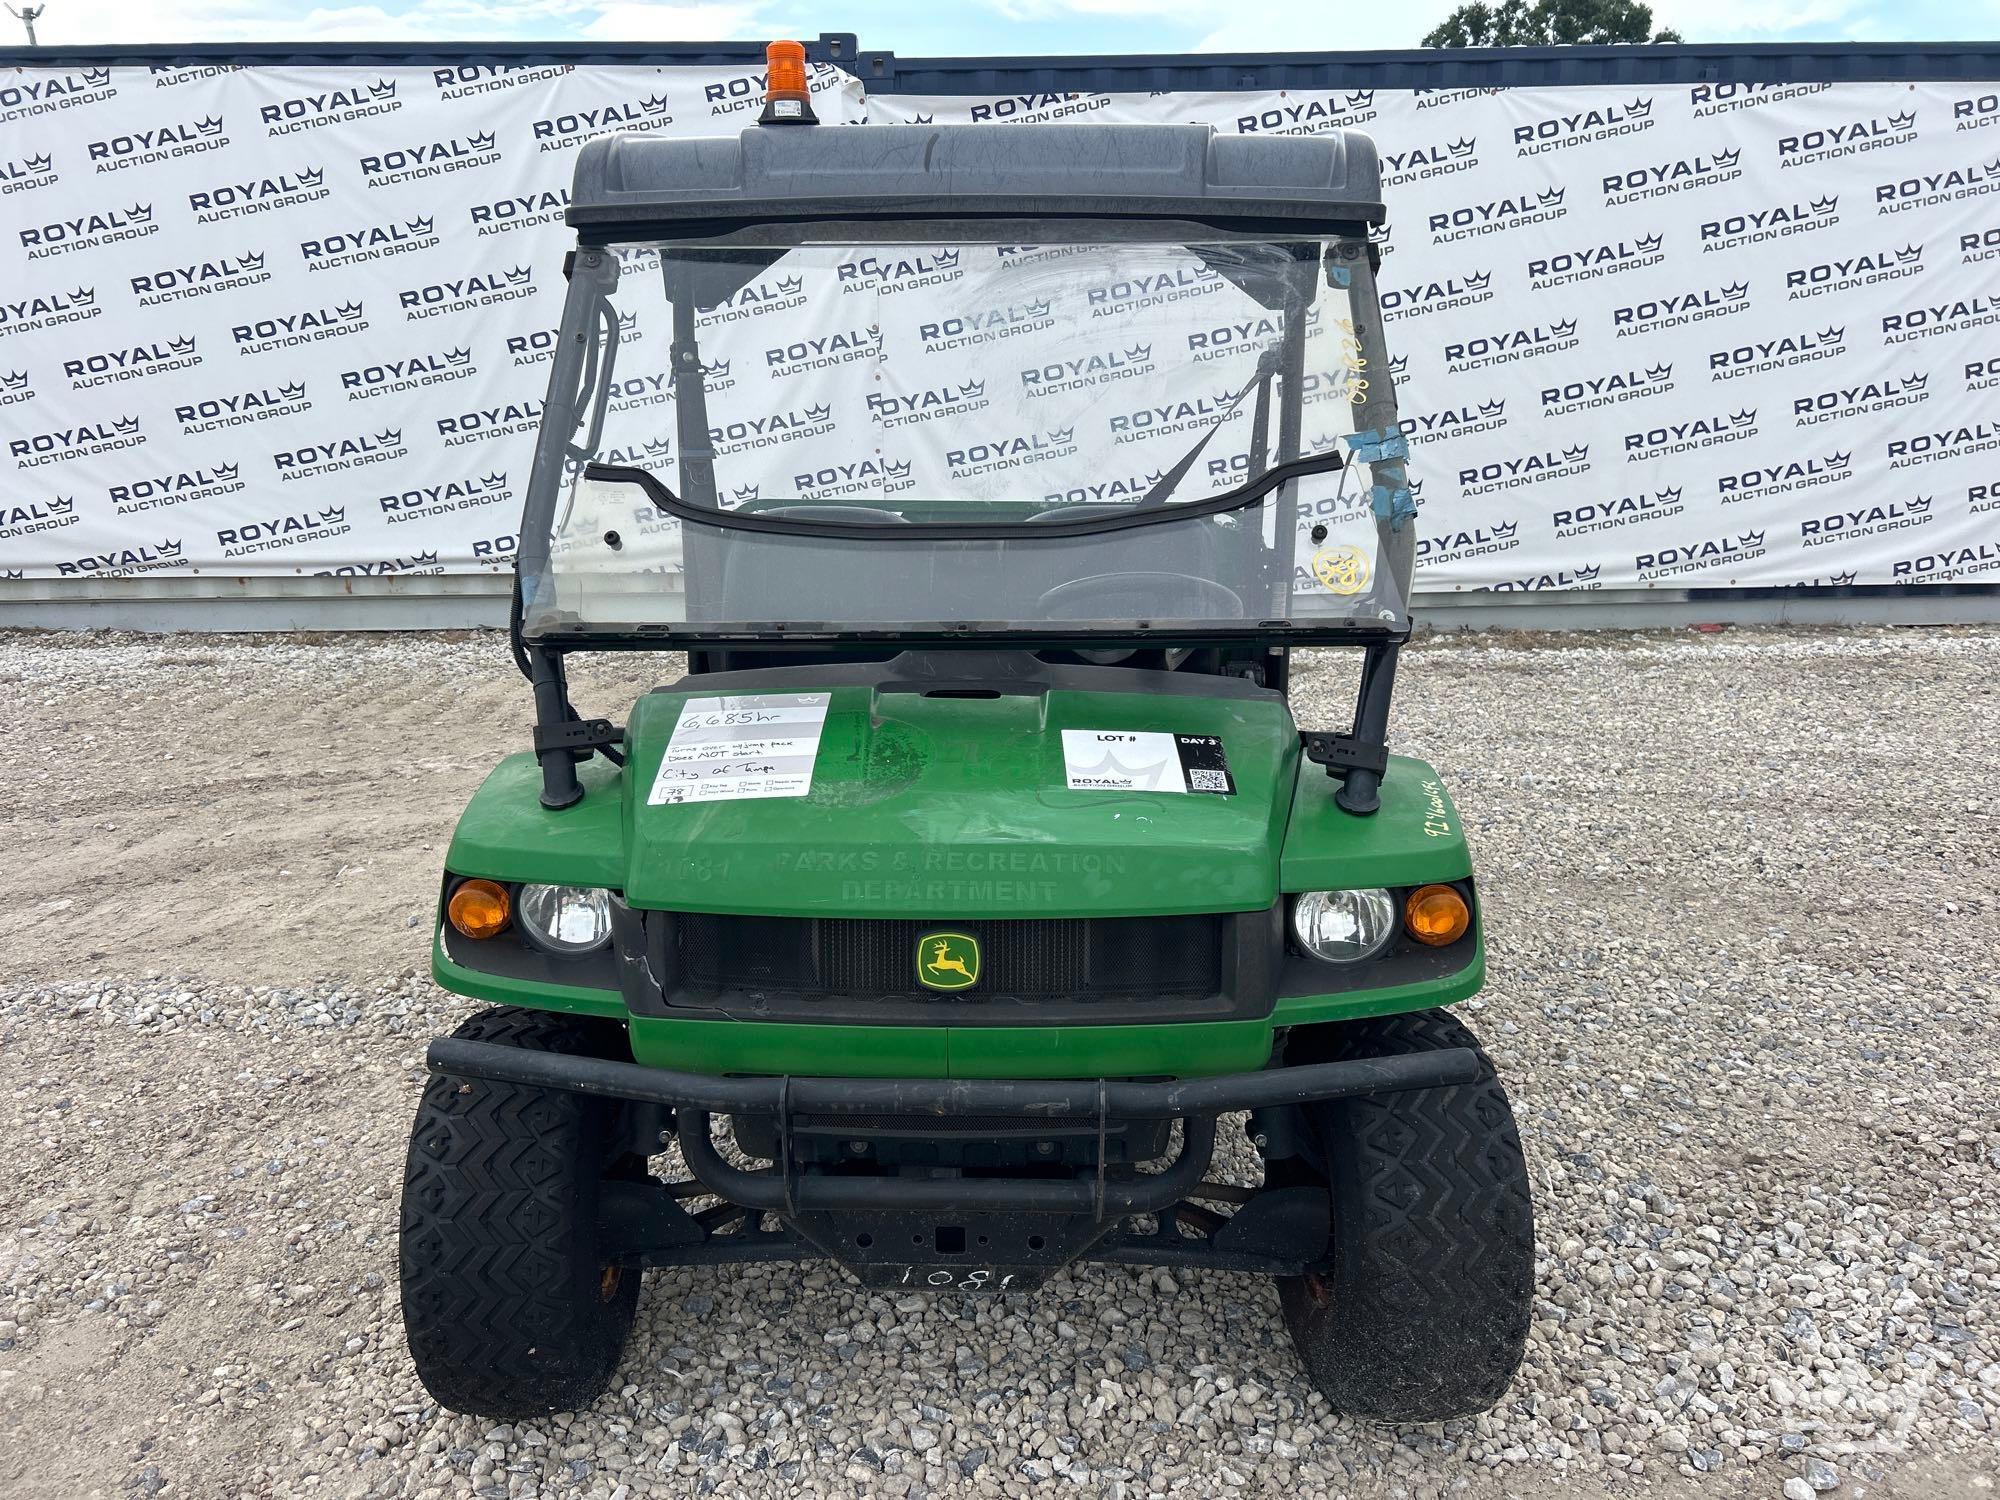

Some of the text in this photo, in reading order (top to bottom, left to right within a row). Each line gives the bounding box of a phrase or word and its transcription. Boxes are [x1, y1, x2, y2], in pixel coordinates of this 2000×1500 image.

[260, 88, 370, 124] ROYAL
[268, 101, 402, 137] AUCTION GROUP
[88, 124, 197, 160] ROYAL
[1514, 107, 1624, 145] ROYAL
[1517, 120, 1654, 158] AUCTION GROUP
[1779, 119, 1888, 156] ROYAL
[96, 138, 230, 174] AUCTION GROUP
[360, 140, 470, 175] ROYAL
[1781, 132, 1918, 169] AUCTION GROUP
[368, 153, 501, 189] AUCTION GROUP
[1603, 157, 1711, 194] ROYAL
[1605, 169, 1742, 207] AUCTION GROUP
[1876, 168, 1983, 202] ROYAL
[189, 176, 299, 211] ROYAL
[198, 189, 330, 224] AUCTION GROUP
[1878, 192, 1951, 215] AUCTION
[19, 212, 127, 247] ROYAL
[1429, 196, 1537, 232] ROYAL
[1433, 208, 1567, 245] AUCTION GROUP
[1701, 204, 1809, 240] ROYAL
[28, 225, 159, 260] AUCTION GROUP
[300, 224, 408, 259] ROYAL
[1703, 216, 1839, 253] AUCTION GROUP
[309, 237, 440, 272] AUCTION GROUP
[1528, 242, 1635, 278] ROYAL
[1787, 253, 1894, 288] ROYAL
[130, 260, 239, 294] ROYAL
[139, 272, 271, 307] AUCTION GROUP
[1088, 270, 1193, 305] ROYAL
[1531, 254, 1664, 291] AUCTION GROUP
[1788, 265, 1924, 301] AUCTION GROUP
[399, 274, 506, 309] ROYAL
[407, 286, 537, 321] AUCTION GROUP
[1092, 282, 1224, 318] AUCTION GROUP
[1614, 290, 1720, 326] ROYAL
[232, 309, 338, 343] ROYAL
[920, 306, 1024, 341] ROYAL
[1616, 302, 1750, 338] AUCTION GROUP
[1883, 298, 1988, 333] ROYAL
[240, 321, 369, 356] AUCTION GROUP
[925, 319, 1055, 353] AUCTION GROUP
[1445, 327, 1550, 362] ROYAL
[1710, 334, 1816, 370] ROYAL
[63, 344, 171, 378] ROYAL
[73, 356, 203, 390] AUCTION GROUP
[341, 355, 446, 389] ROYAL
[1021, 352, 1125, 386] ROYAL
[1448, 339, 1579, 374] AUCTION GROUP
[1712, 346, 1846, 382] AUCTION GROUP
[349, 367, 477, 401] AUCTION GROUP
[1026, 364, 1155, 399] AUCTION GROUP
[1541, 371, 1645, 406] ROYAL
[1794, 381, 1900, 415] ROYAL
[174, 390, 281, 423] ROYAL
[1110, 399, 1214, 432] ROYAL
[1544, 383, 1674, 418] AUCTION GROUP
[1796, 392, 1929, 427] AUCTION GROUP
[184, 402, 312, 435] AUCTION GROUP
[1114, 410, 1243, 445] AUCTION GROUP
[1625, 417, 1729, 451] ROYAL
[9, 424, 115, 457] ROYAL
[18, 436, 146, 469] AUCTION GROUP
[273, 437, 378, 470] ROYAL
[946, 434, 1048, 467] ROYAL
[1627, 428, 1758, 463] AUCTION GROUP
[1888, 424, 1991, 458] ROYAL
[282, 448, 408, 482] AUCTION GROUP
[952, 446, 1078, 480] AUCTION GROUP
[1459, 452, 1562, 486] ROYAL
[1462, 463, 1591, 498] AUCTION GROUP
[1718, 459, 1823, 493] ROYAL
[108, 470, 214, 503] ROYAL
[117, 482, 245, 515] AUCTION GROUP
[379, 480, 483, 513] ROYAL
[1721, 471, 1852, 505] AUCTION GROUP
[387, 491, 512, 524] AUCTION GROUP
[1553, 494, 1655, 527] ROYAL
[1556, 505, 1684, 539] AUCTION GROUP
[1801, 504, 1904, 536] ROYAL
[217, 514, 321, 546] ROYAL
[225, 525, 351, 558] AUCTION GROUP
[1802, 514, 1933, 548] AUCTION GROUP
[1636, 538, 1738, 570] ROYAL
[1638, 548, 1766, 582] AUCTION GROUP
[697, 750, 729, 759] NOT
[1096, 734, 1124, 742] LOT
[1181, 737, 1206, 745] DAY
[662, 762, 775, 779] City of Tampa
[776, 851, 880, 871] PARKS
[925, 851, 1126, 873] RECREATION
[842, 880, 1057, 901] DEPARTMENT
